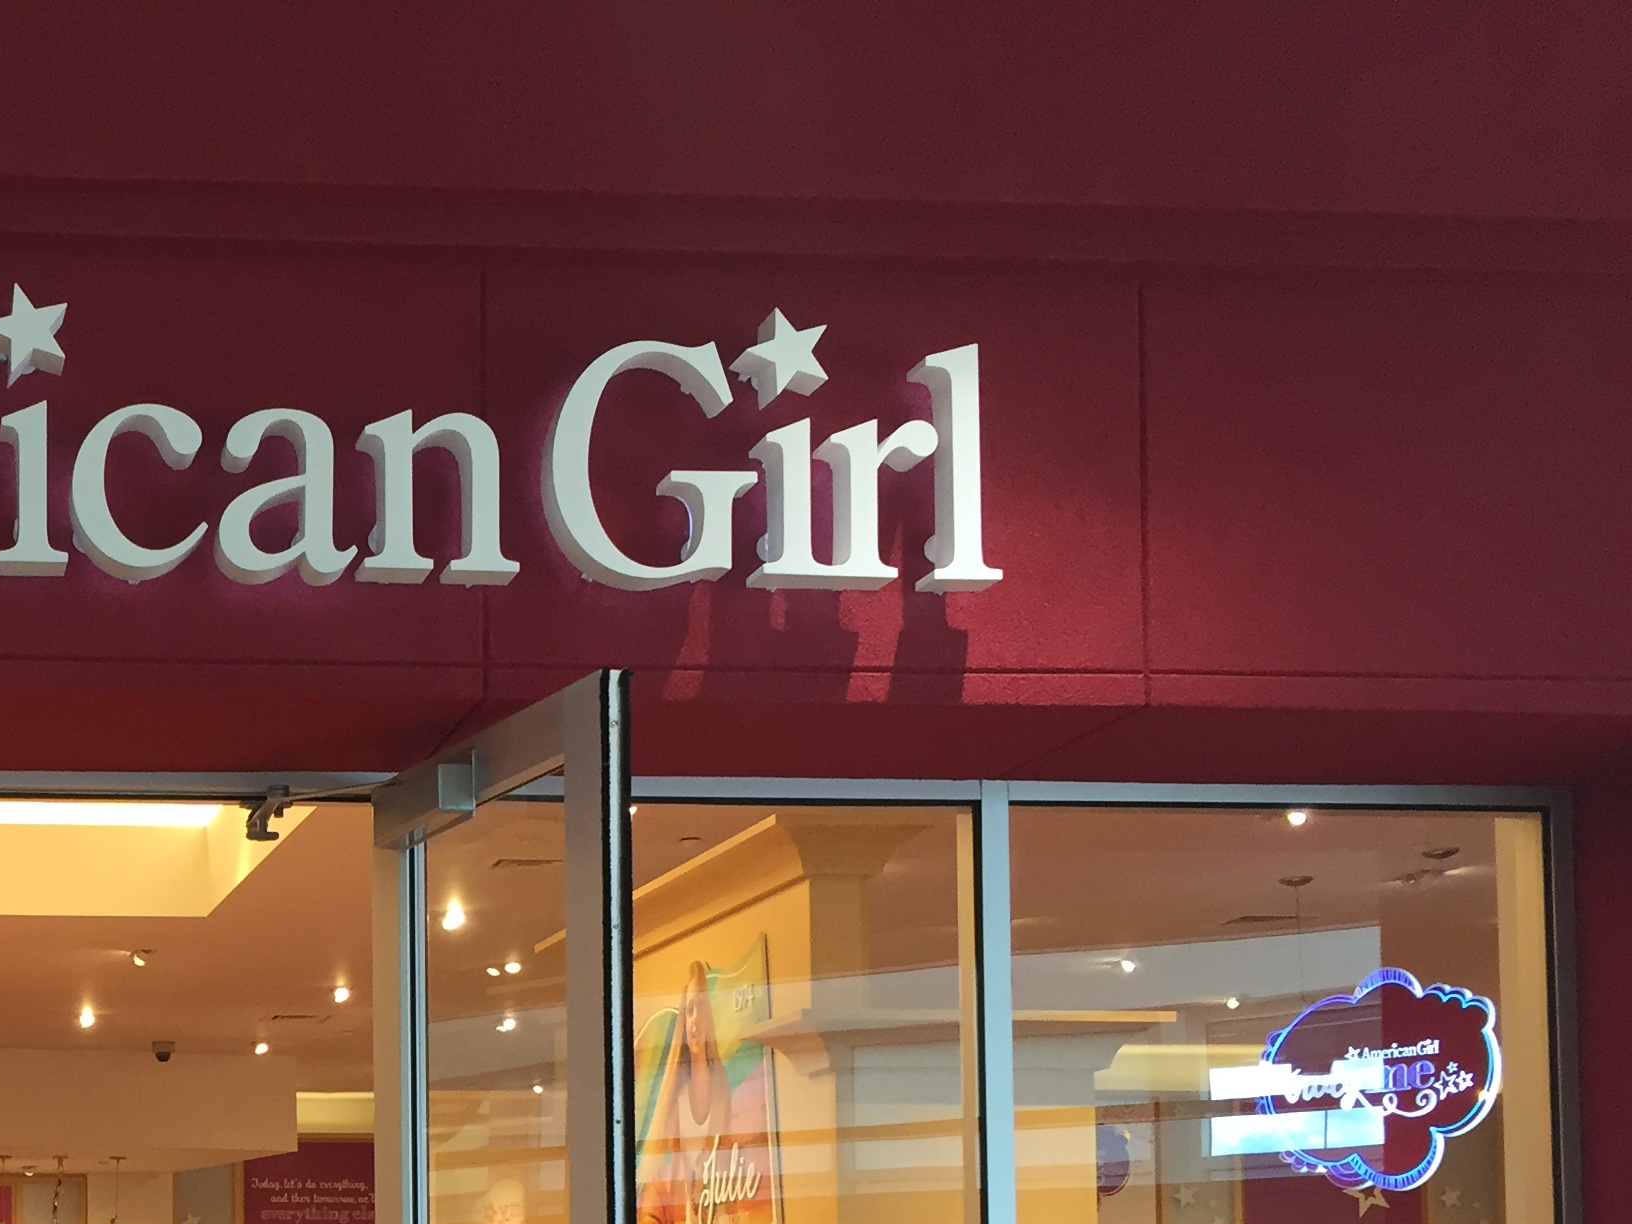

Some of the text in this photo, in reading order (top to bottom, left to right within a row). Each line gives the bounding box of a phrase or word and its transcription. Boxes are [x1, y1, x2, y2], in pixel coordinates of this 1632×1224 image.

[541, 307, 1004, 592] Girl
[1361, 1039, 1439, 1059] American Girl
[260, 1204, 375, 1224] everything els
